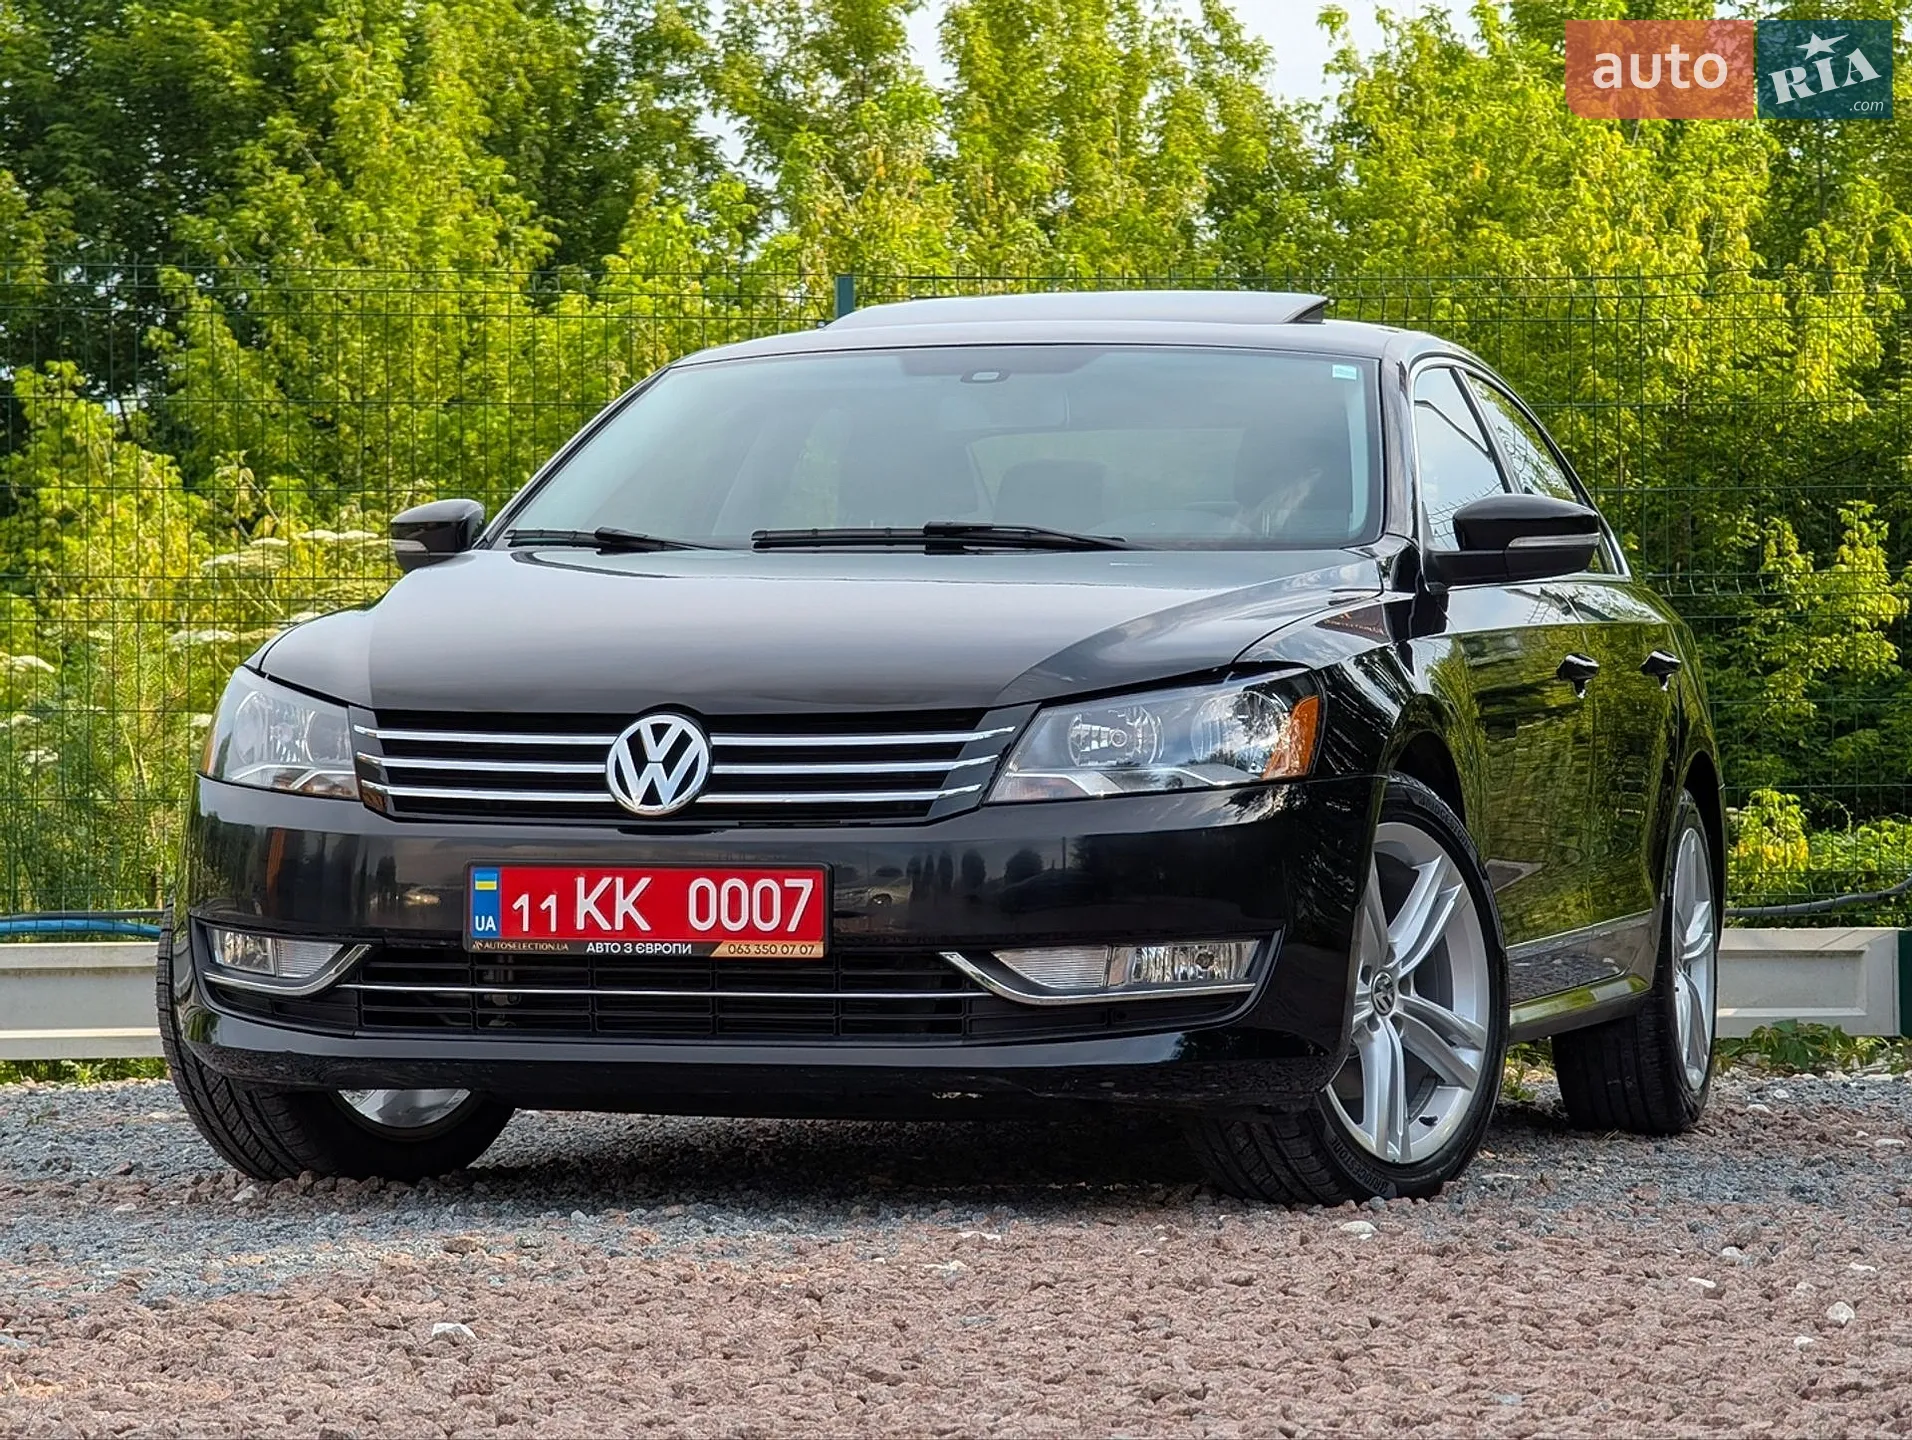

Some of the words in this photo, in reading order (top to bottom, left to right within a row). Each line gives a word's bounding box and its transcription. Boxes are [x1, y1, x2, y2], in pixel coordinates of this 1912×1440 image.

[511, 893, 557, 932] 11
[575, 877, 652, 932] KK
[687, 877, 814, 932] 0007
[474, 915, 496, 932] UA
[483, 941, 569, 952] AUTOSELECTION.UA
[586, 942, 622, 954] АВТО
[635, 942, 692, 955] ЄВРОПИ
[727, 944, 753, 955] 063
[754, 944, 778, 955] 350
[780, 944, 797, 955] 07
[799, 944, 815, 955] 07
